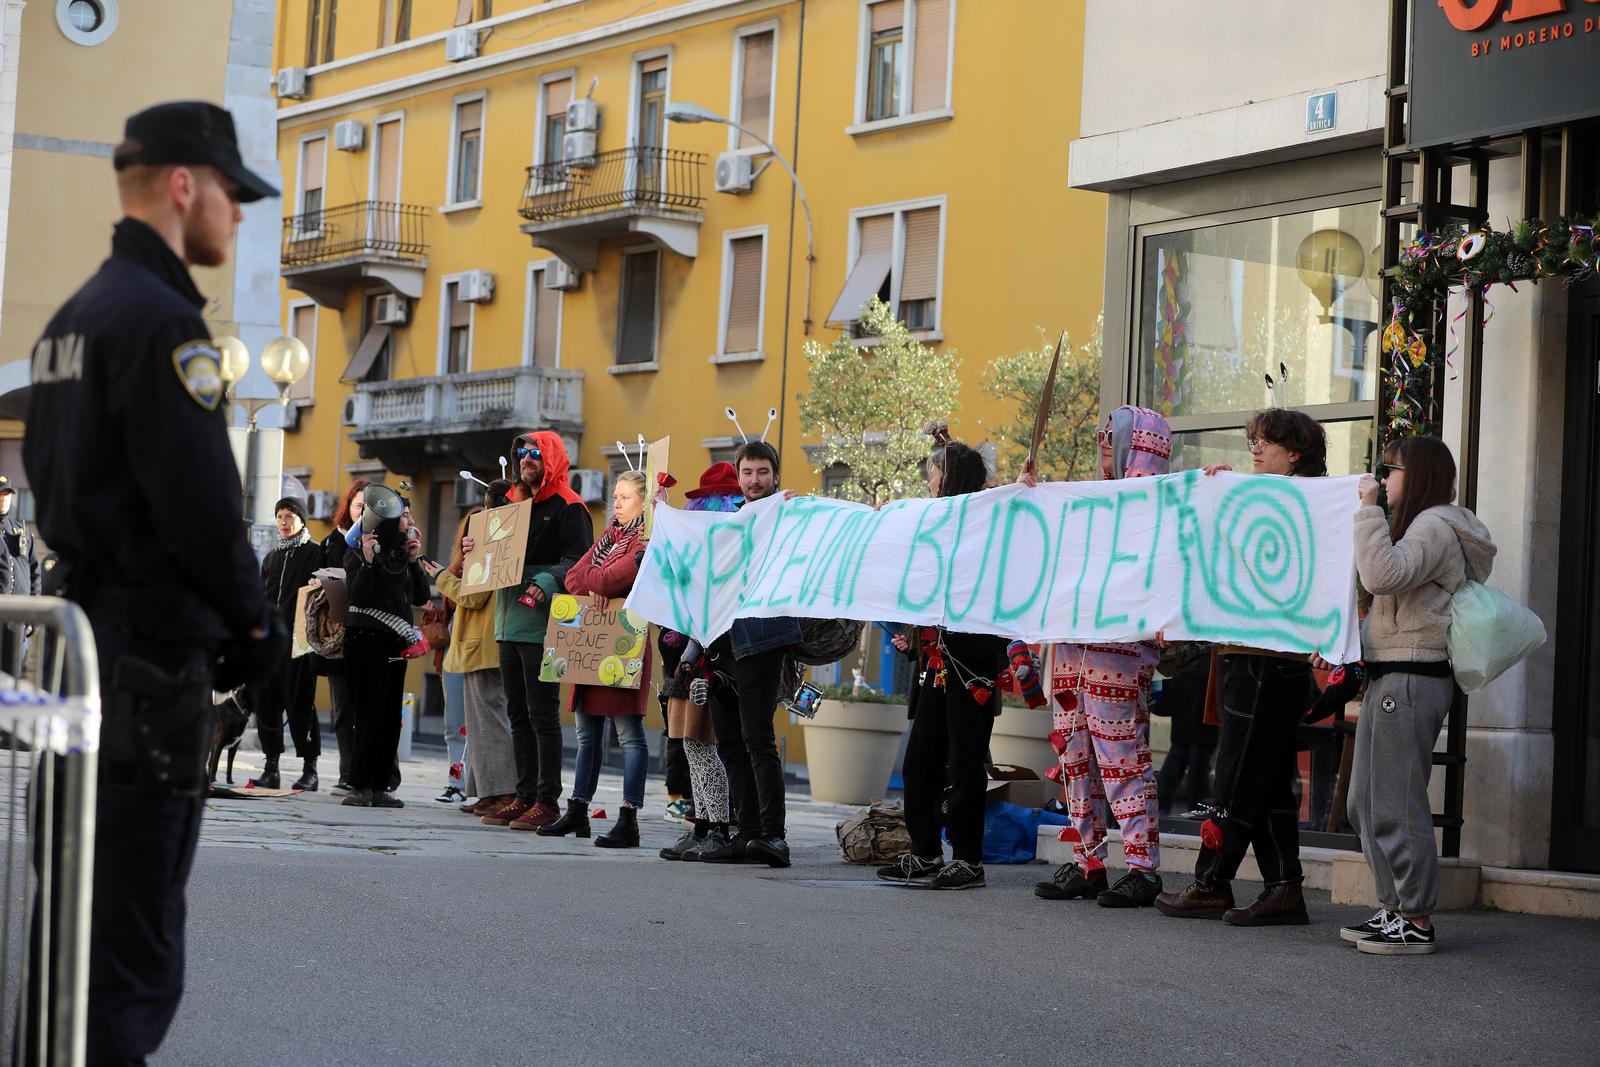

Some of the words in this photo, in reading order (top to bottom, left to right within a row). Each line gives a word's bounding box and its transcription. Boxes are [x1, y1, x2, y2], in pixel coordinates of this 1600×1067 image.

[1471, 39, 1492, 57] BY
[1500, 22, 1574, 51] MORENO
[1314, 97, 1324, 119] 4
[898, 474, 1163, 631] BUDITE!
[556, 627, 609, 650] PUŽNE
[566, 649, 603, 672] FACE
